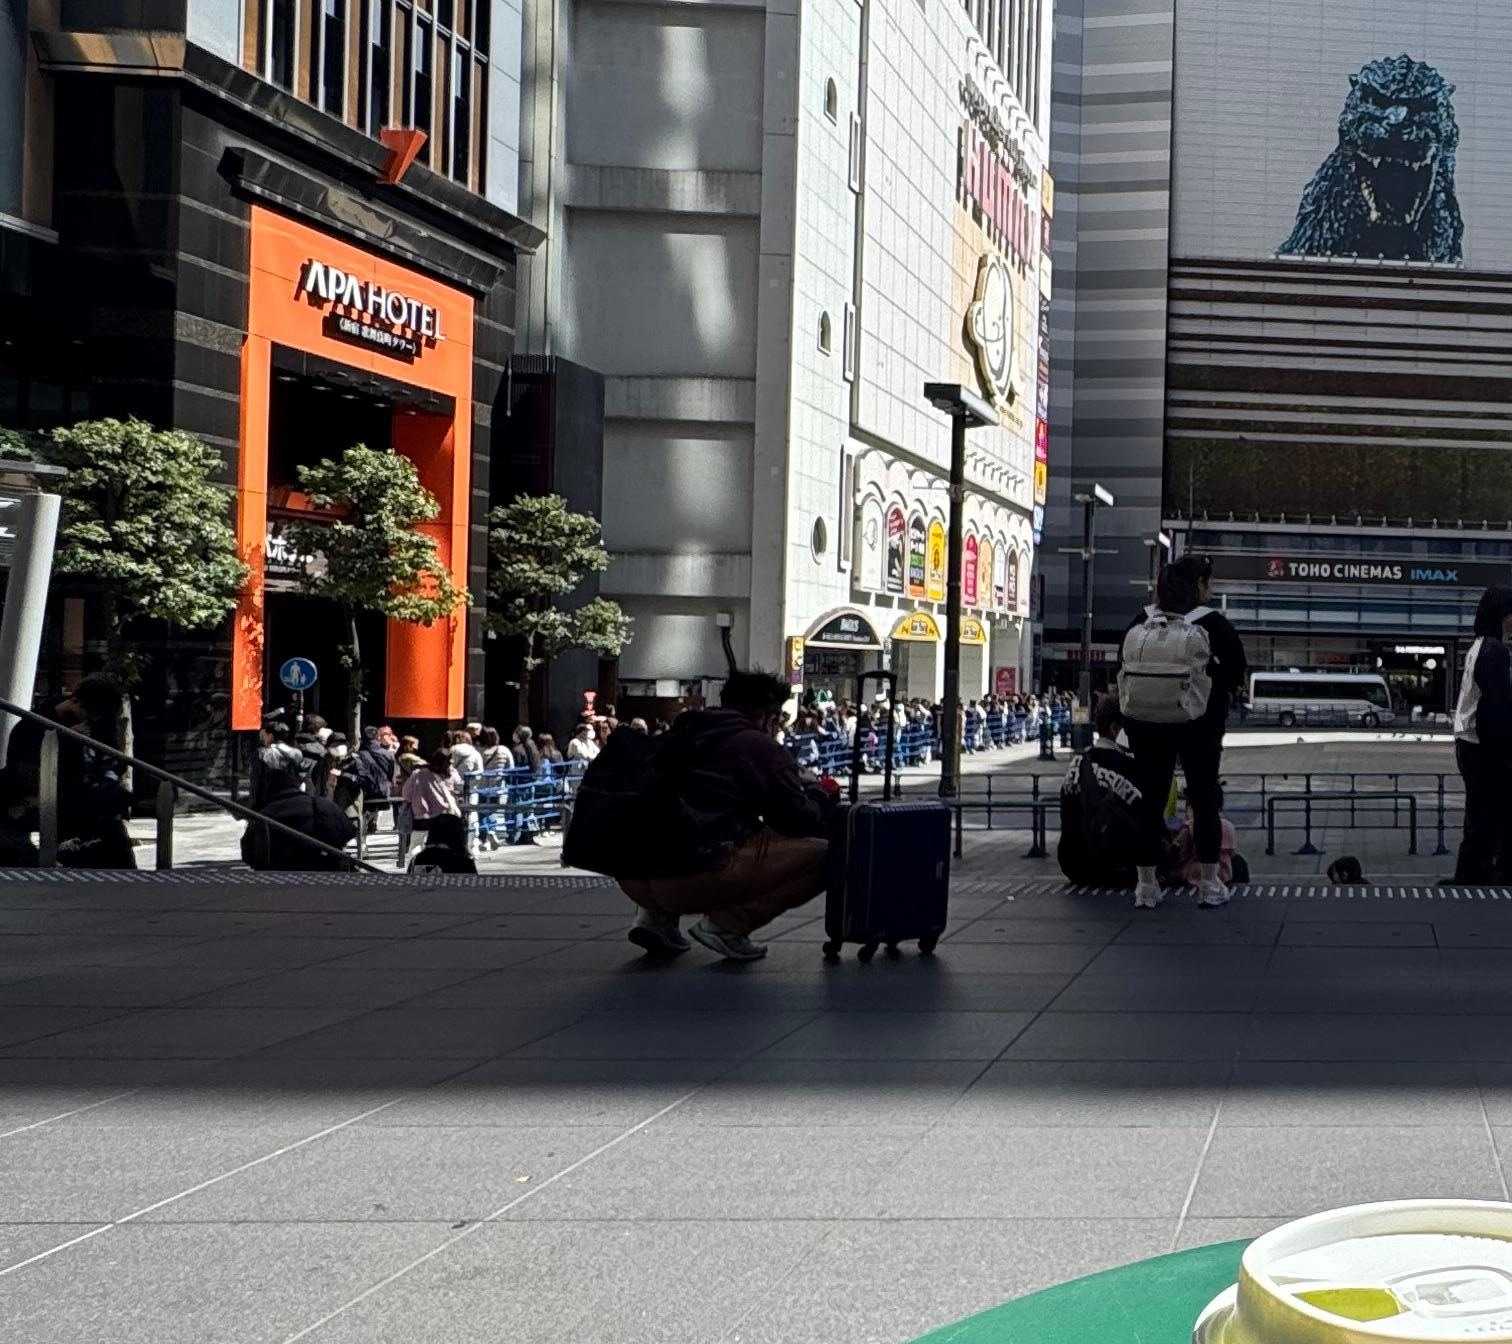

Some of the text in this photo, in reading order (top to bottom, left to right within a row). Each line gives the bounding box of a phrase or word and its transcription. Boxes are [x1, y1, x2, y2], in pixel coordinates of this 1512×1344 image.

[306, 260, 446, 341] APA HOTEL
[1288, 563, 1458, 582] TOHO CINEMAS IMAX
